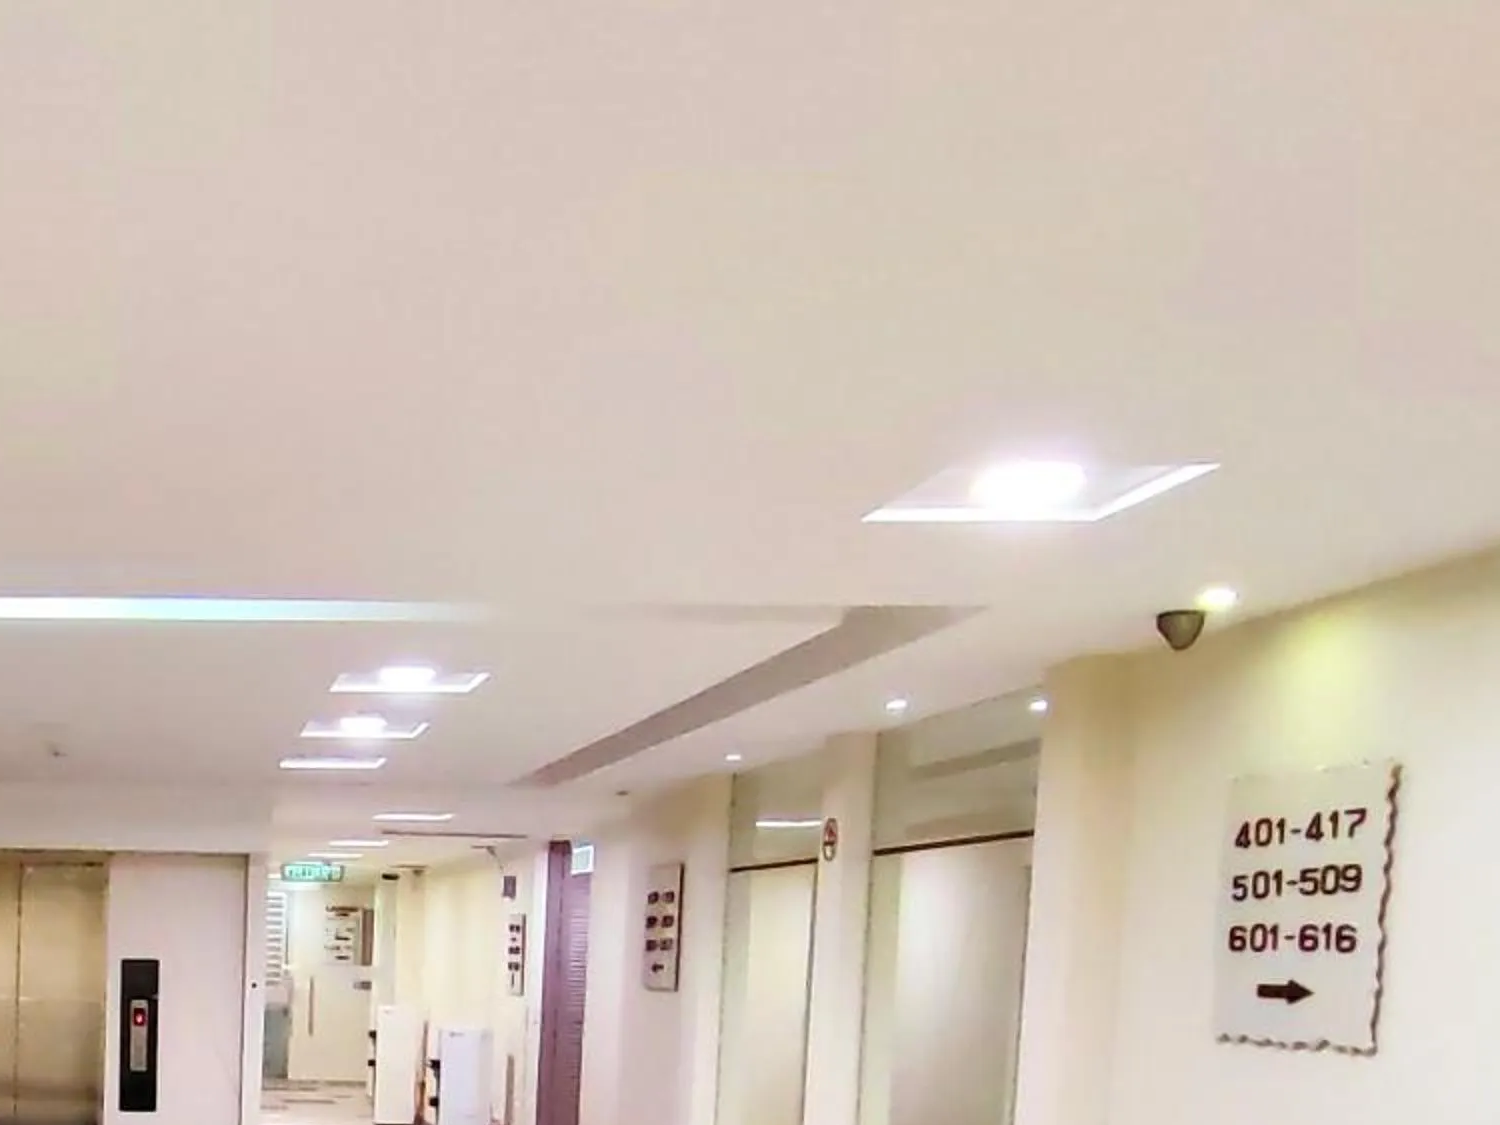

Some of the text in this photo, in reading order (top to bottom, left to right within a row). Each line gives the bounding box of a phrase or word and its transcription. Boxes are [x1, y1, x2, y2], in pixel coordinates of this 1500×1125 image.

[1234, 808, 1367, 849] 401-417
[1231, 864, 1363, 901] 501-509
[1228, 923, 1358, 953] 601-616
